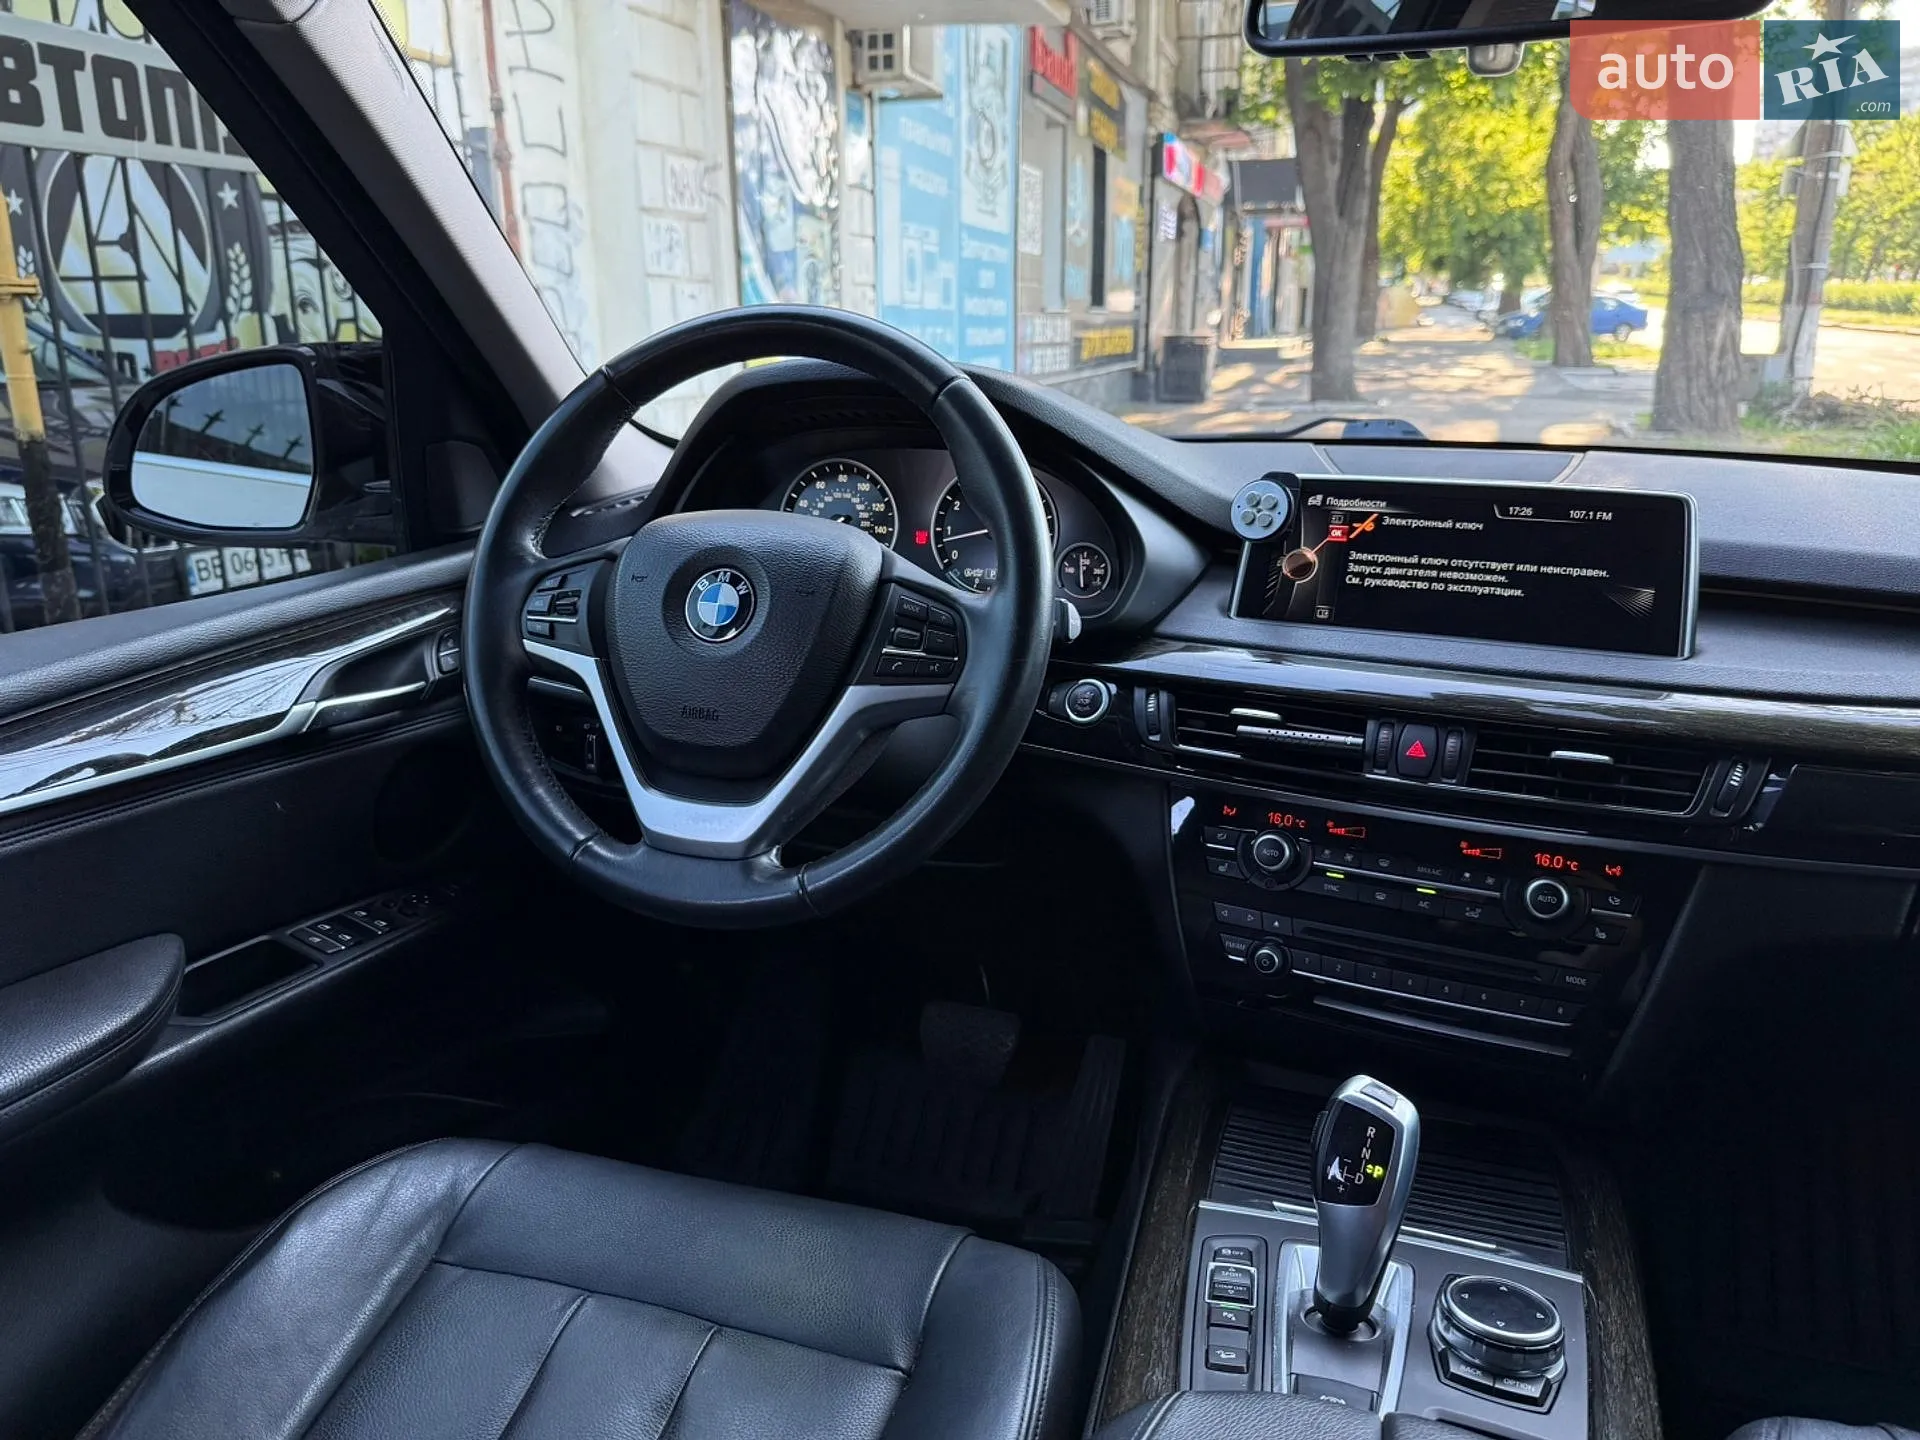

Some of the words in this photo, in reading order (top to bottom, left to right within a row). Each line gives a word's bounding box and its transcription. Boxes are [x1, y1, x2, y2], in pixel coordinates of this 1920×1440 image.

[837, 474, 849, 483] 80
[815, 481, 826, 490] 60
[857, 482, 871, 492] 100
[871, 503, 885, 512] 120
[953, 501, 961, 511] 2
[1326, 497, 1387, 509] Подробности
[1569, 510, 1594, 520] 107.1
[1596, 511, 1613, 521] FM
[874, 526, 888, 534] 140
[1382, 516, 1453, 529] Электронный
[1455, 521, 1484, 531] ключ
[946, 526, 951, 535] 1
[951, 550, 959, 561] 0
[1349, 551, 1419, 564] Электронный
[1421, 557, 1449, 567] ключ
[1451, 559, 1514, 572] отсутствует
[1516, 564, 1538, 573] или
[1540, 565, 1610, 578] неисправен.
[1347, 563, 1382, 576] Запуск
[1383, 566, 1437, 578] двигателя
[1439, 570, 1509, 583] невозможен.
[697, 571, 750, 596] BMW
[1345, 575, 1363, 585] См.
[1364, 577, 1429, 591] руководство
[1431, 582, 1445, 591] по
[1447, 583, 1525, 597] эксплуатации.
[680, 705, 719, 722] AIRBAG
[1268, 811, 1294, 827] 16.0
[1534, 851, 1562, 869] 16.0
[1537, 894, 1558, 904] AUTO
[1565, 975, 1588, 987] MODE
[1366, 1126, 1376, 1139] R
[1361, 1147, 1371, 1160] N
[1373, 1165, 1384, 1178] P
[1354, 1172, 1365, 1185] D
[1503, 1377, 1536, 1393] OPTION
